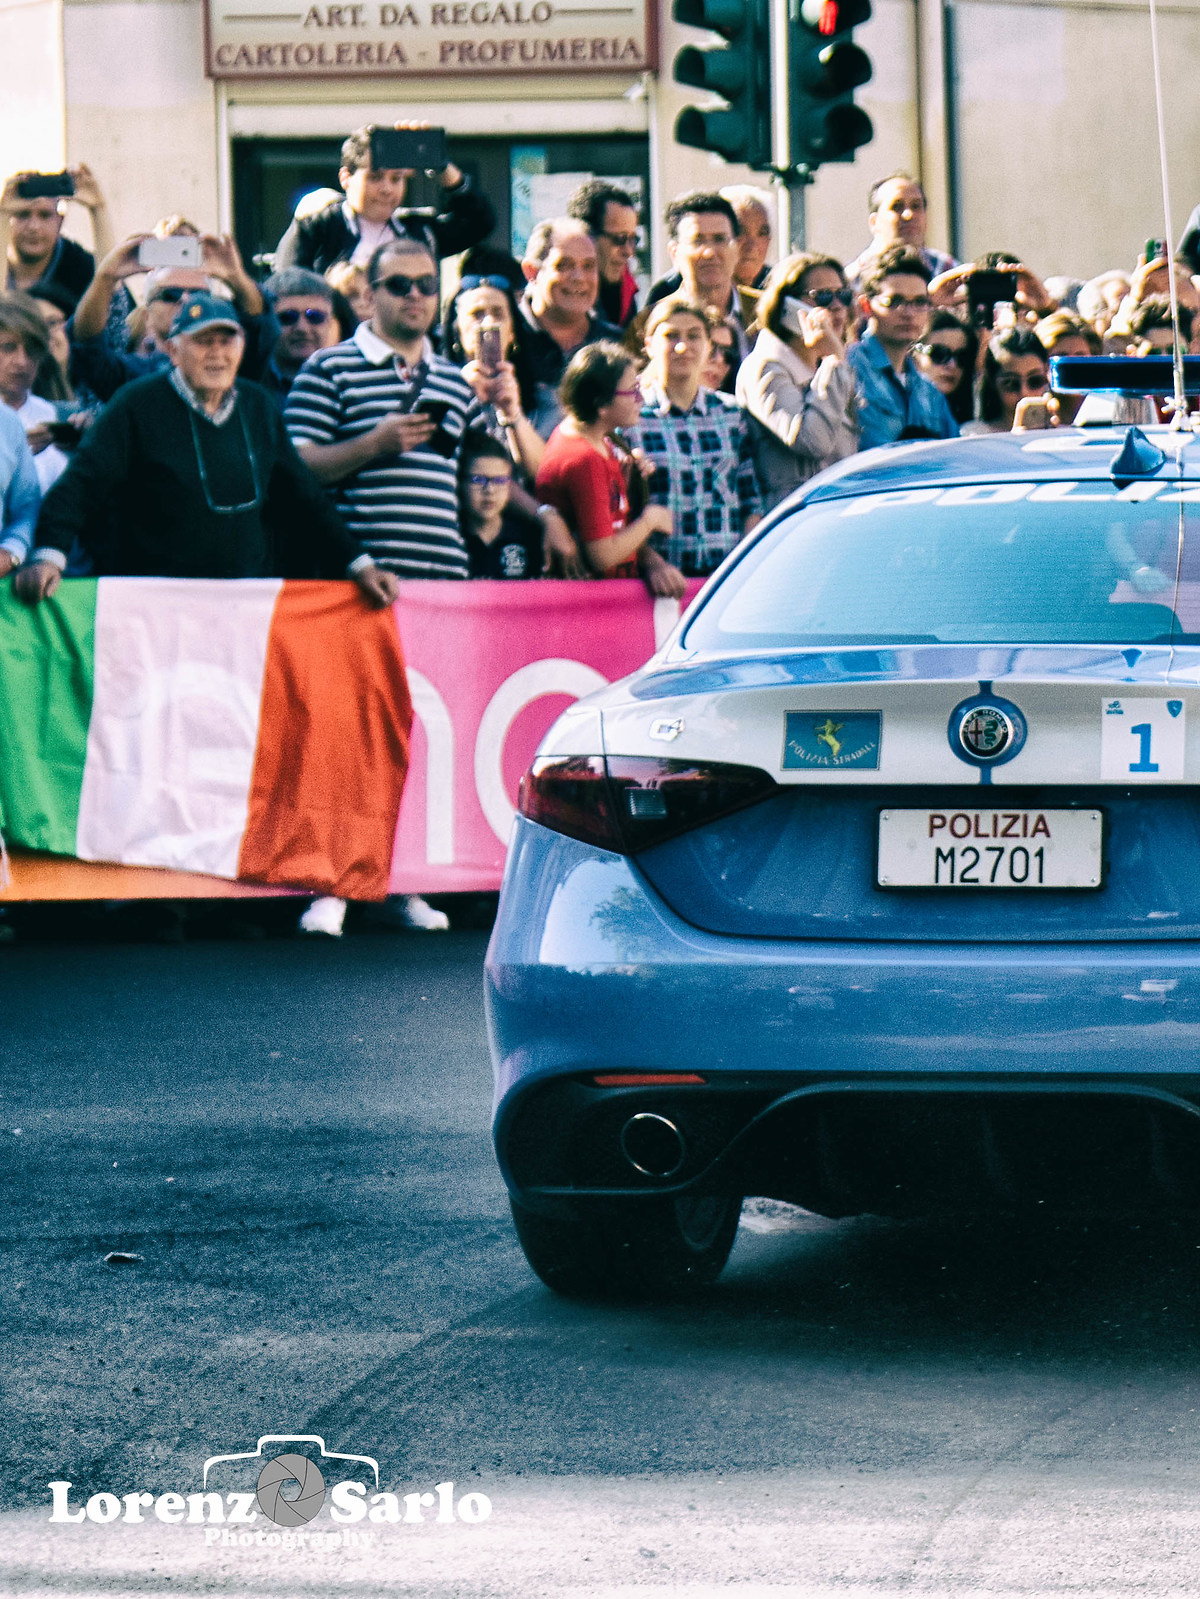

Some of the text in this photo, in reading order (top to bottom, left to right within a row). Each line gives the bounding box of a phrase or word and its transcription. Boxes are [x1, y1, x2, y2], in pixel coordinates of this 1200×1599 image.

[303, 1, 552, 28] ART. DA REGALO
[215, 42, 408, 67] CARTOLERIA
[439, 38, 643, 63] PROFUMERIA
[788, 740, 876, 766] POLIZIA STRADALE
[1129, 723, 1159, 773] 1
[928, 813, 1051, 839] POLIZIA
[934, 846, 1044, 884] M2701
